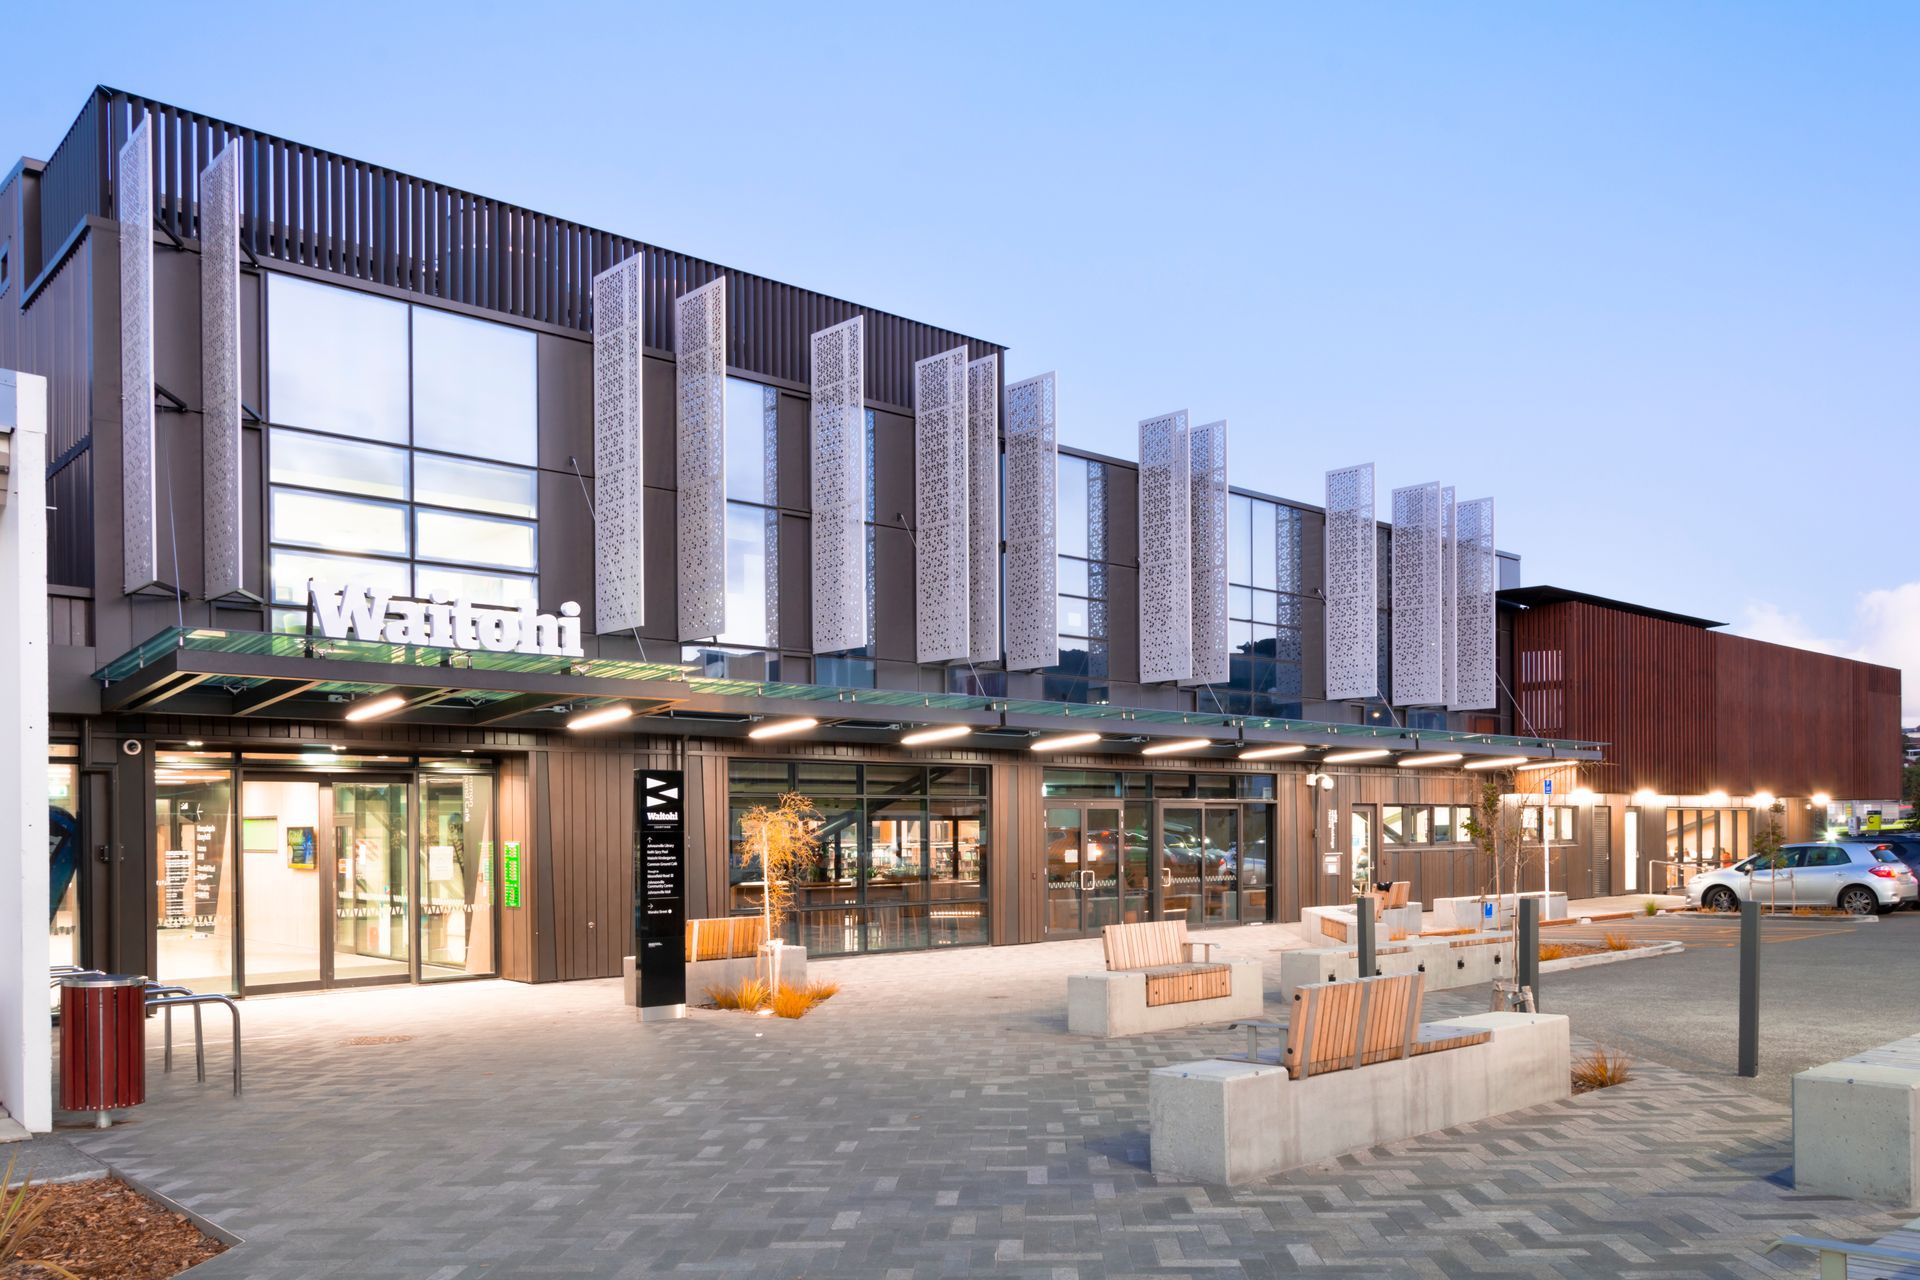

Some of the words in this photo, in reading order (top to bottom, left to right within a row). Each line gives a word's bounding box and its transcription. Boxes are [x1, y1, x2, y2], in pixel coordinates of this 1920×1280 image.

[308, 579, 584, 657] Waitohi
[647, 812, 678, 820] Waitohi
[1868, 816, 1874, 824] C
